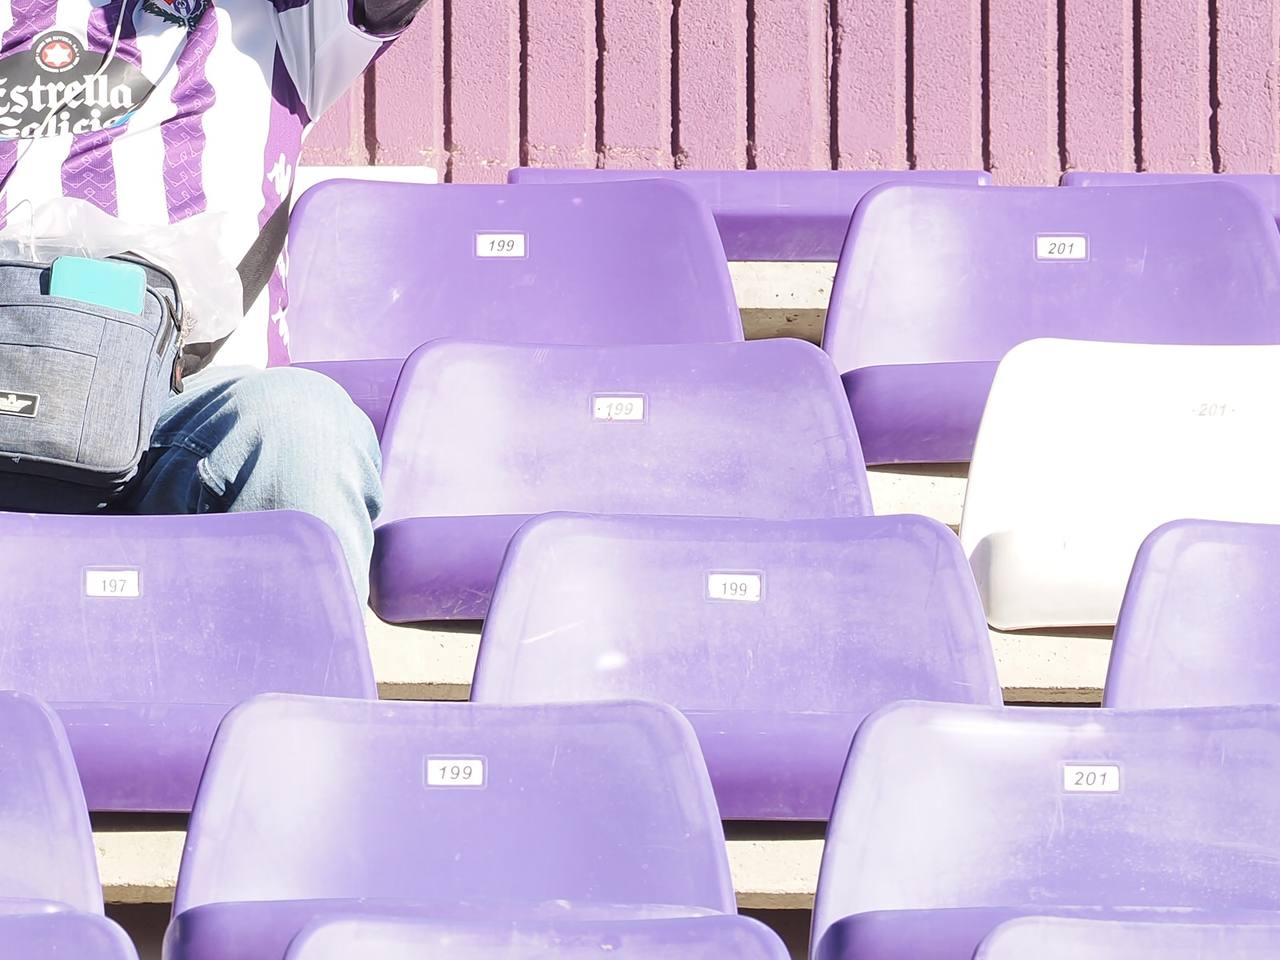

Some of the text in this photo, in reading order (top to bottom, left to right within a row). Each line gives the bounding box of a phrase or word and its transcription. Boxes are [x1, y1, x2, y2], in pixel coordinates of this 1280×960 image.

[489, 239, 515, 252] 199
[1048, 242, 1074, 255] 201
[606, 402, 634, 416] 199
[101, 578, 128, 593] 197
[721, 581, 747, 596] 199
[439, 765, 473, 780] 199
[1073, 771, 1107, 786] 201
